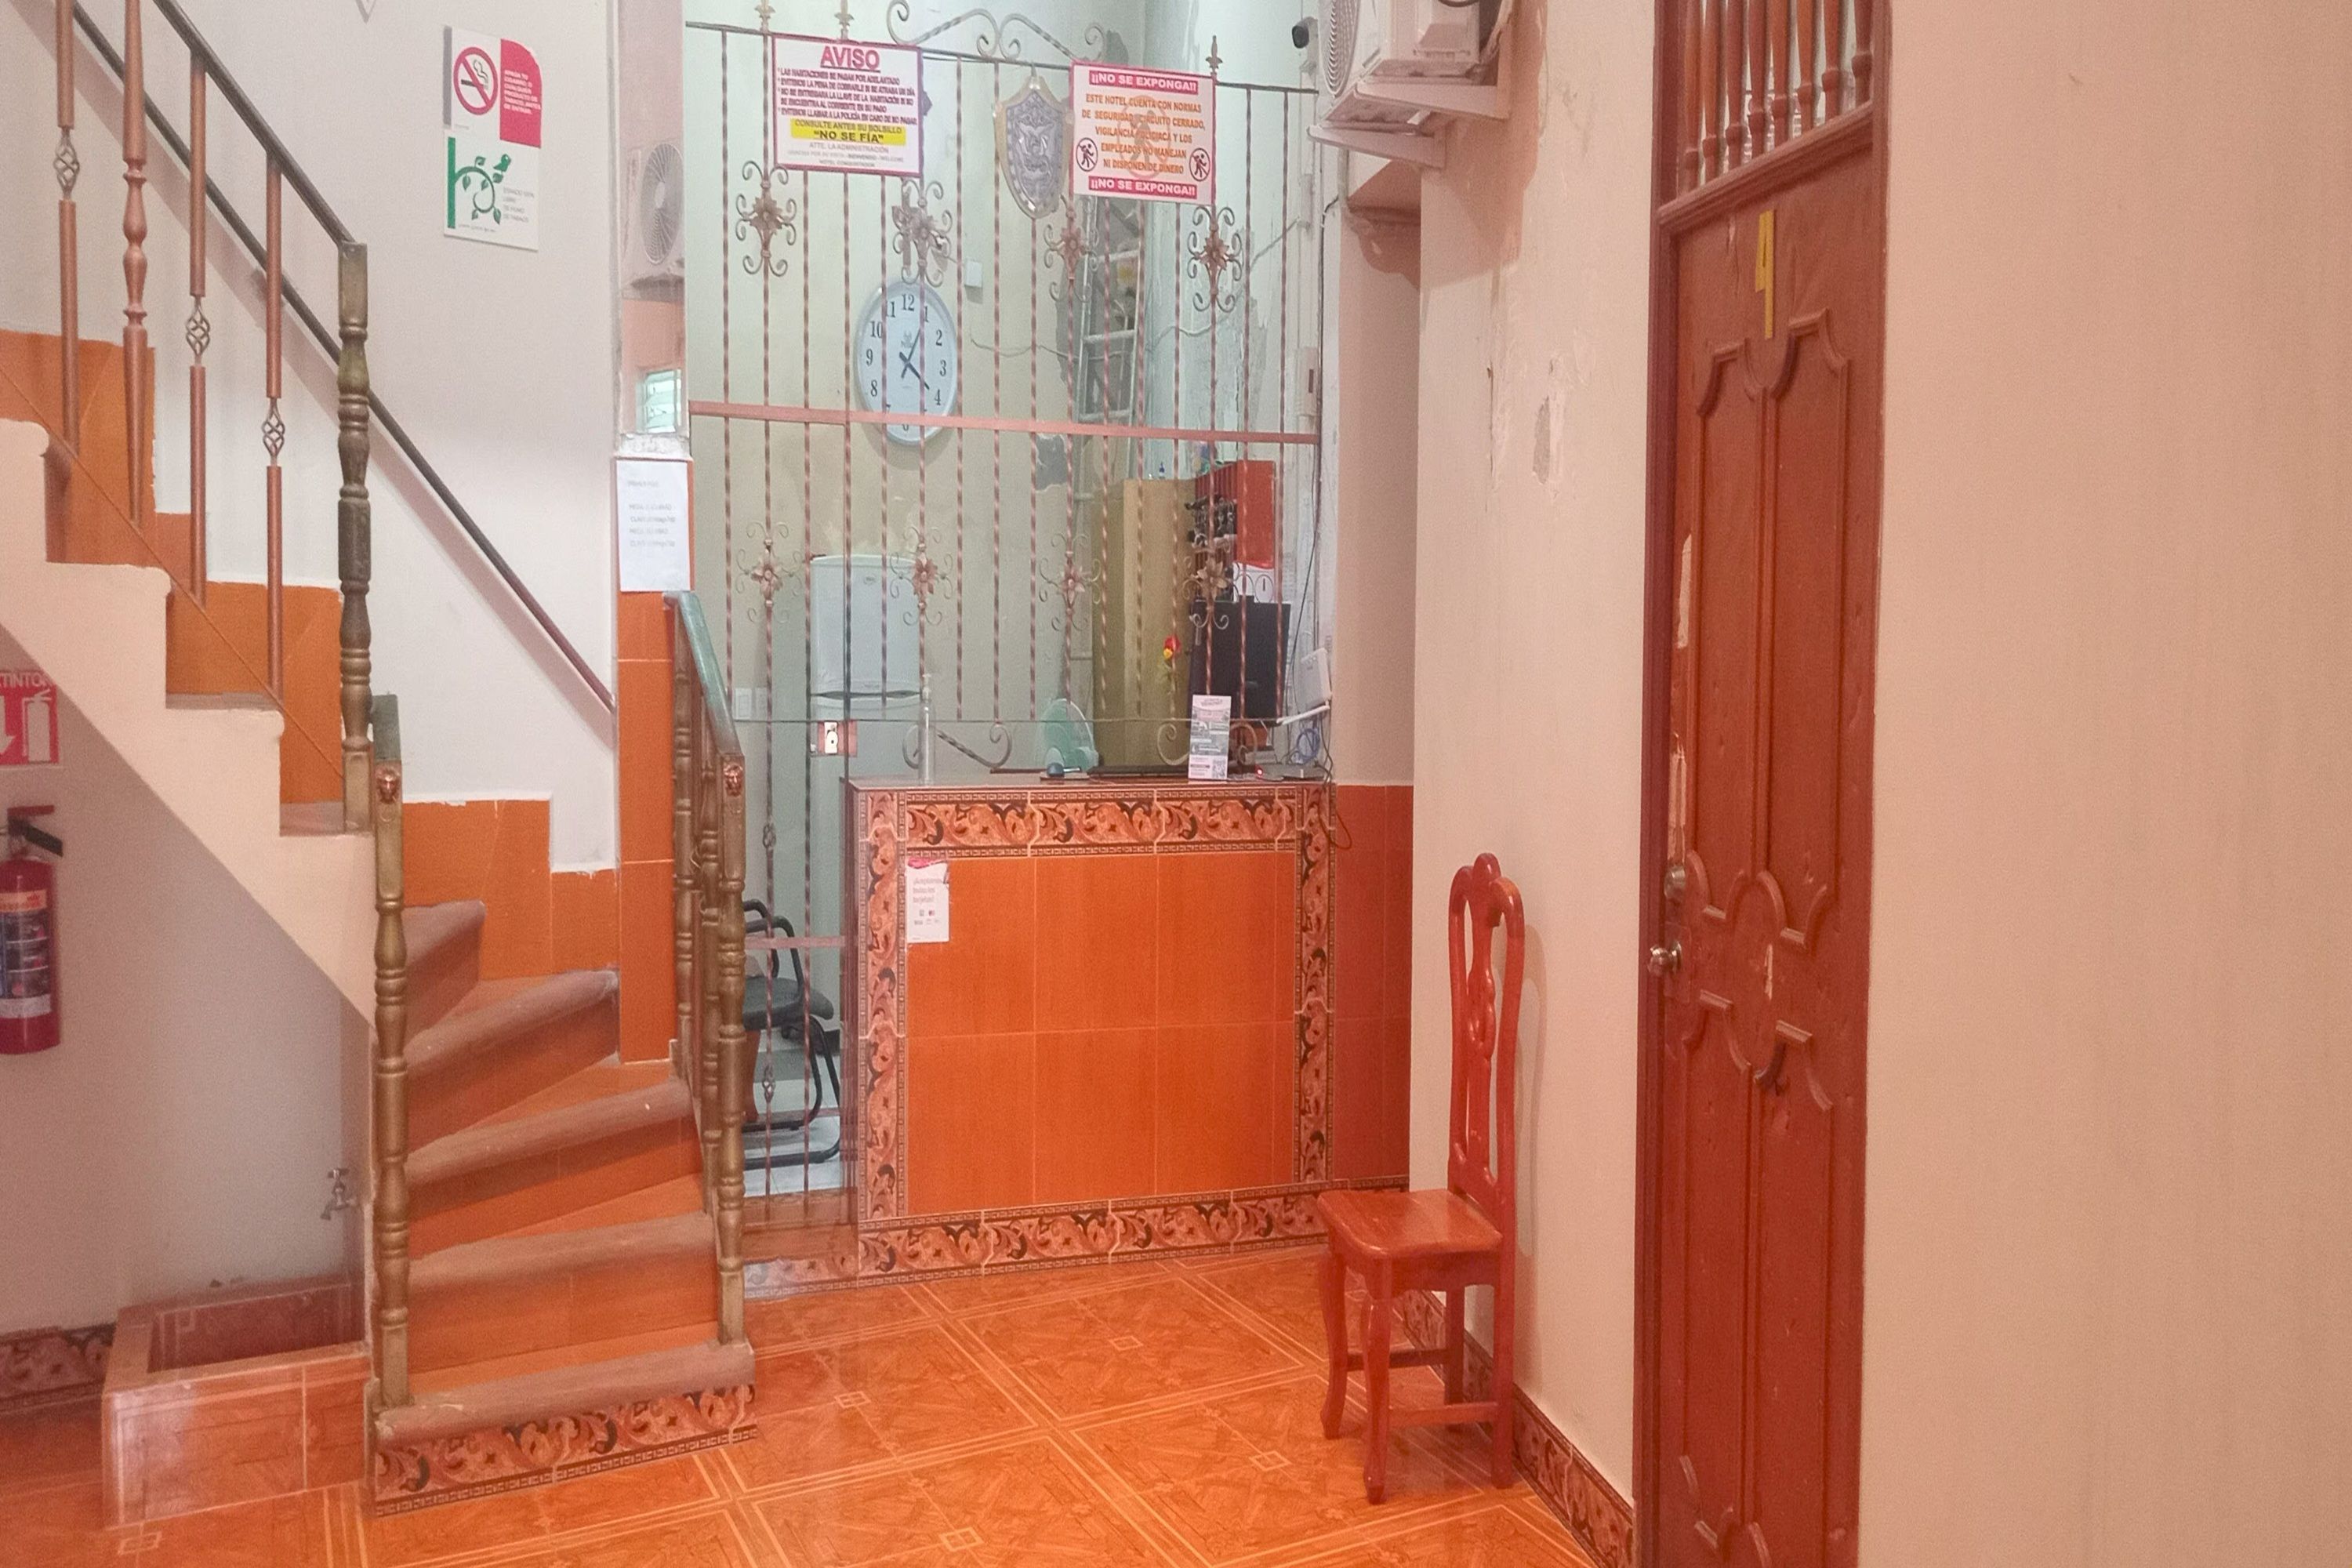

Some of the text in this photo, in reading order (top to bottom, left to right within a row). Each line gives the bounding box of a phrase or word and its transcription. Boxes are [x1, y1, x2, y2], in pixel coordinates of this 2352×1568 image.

[820, 45, 880, 70] AVISO
[792, 69, 829, 79] HABITACIONES
[867, 75, 901, 85] ADELANTADO
[1118, 74, 1134, 85] SE
[1086, 93, 1201, 113] ESTE HOTEL CUENTA CON NORMAS
[1082, 109, 1091, 118] DE
[1139, 114, 1171, 125] CIRCUITO
[795, 118, 832, 129] CONSULTE
[833, 122, 856, 131] ANTES
[868, 124, 902, 133] BOLSILLO
[840, 132, 856, 141] SE
[1095, 126, 1134, 137] VIGILANCIA
[1173, 133, 1178, 142] Y
[1179, 133, 1192, 143] LOS
[1101, 143, 1187, 158] EMPLEADOS NO MANEJAN
[1103, 158, 1184, 174] NI DISPONEN DE DINERO
[1118, 180, 1133, 191] SE
[902, 294, 915, 311] 12
[924, 306, 929, 322] 1
[870, 321, 883, 339] 10
[935, 329, 942, 346] 2
[866, 349, 873, 366] 9
[939, 360, 946, 376] 3
[870, 379, 877, 397] 8
[935, 389, 941, 405] 4
